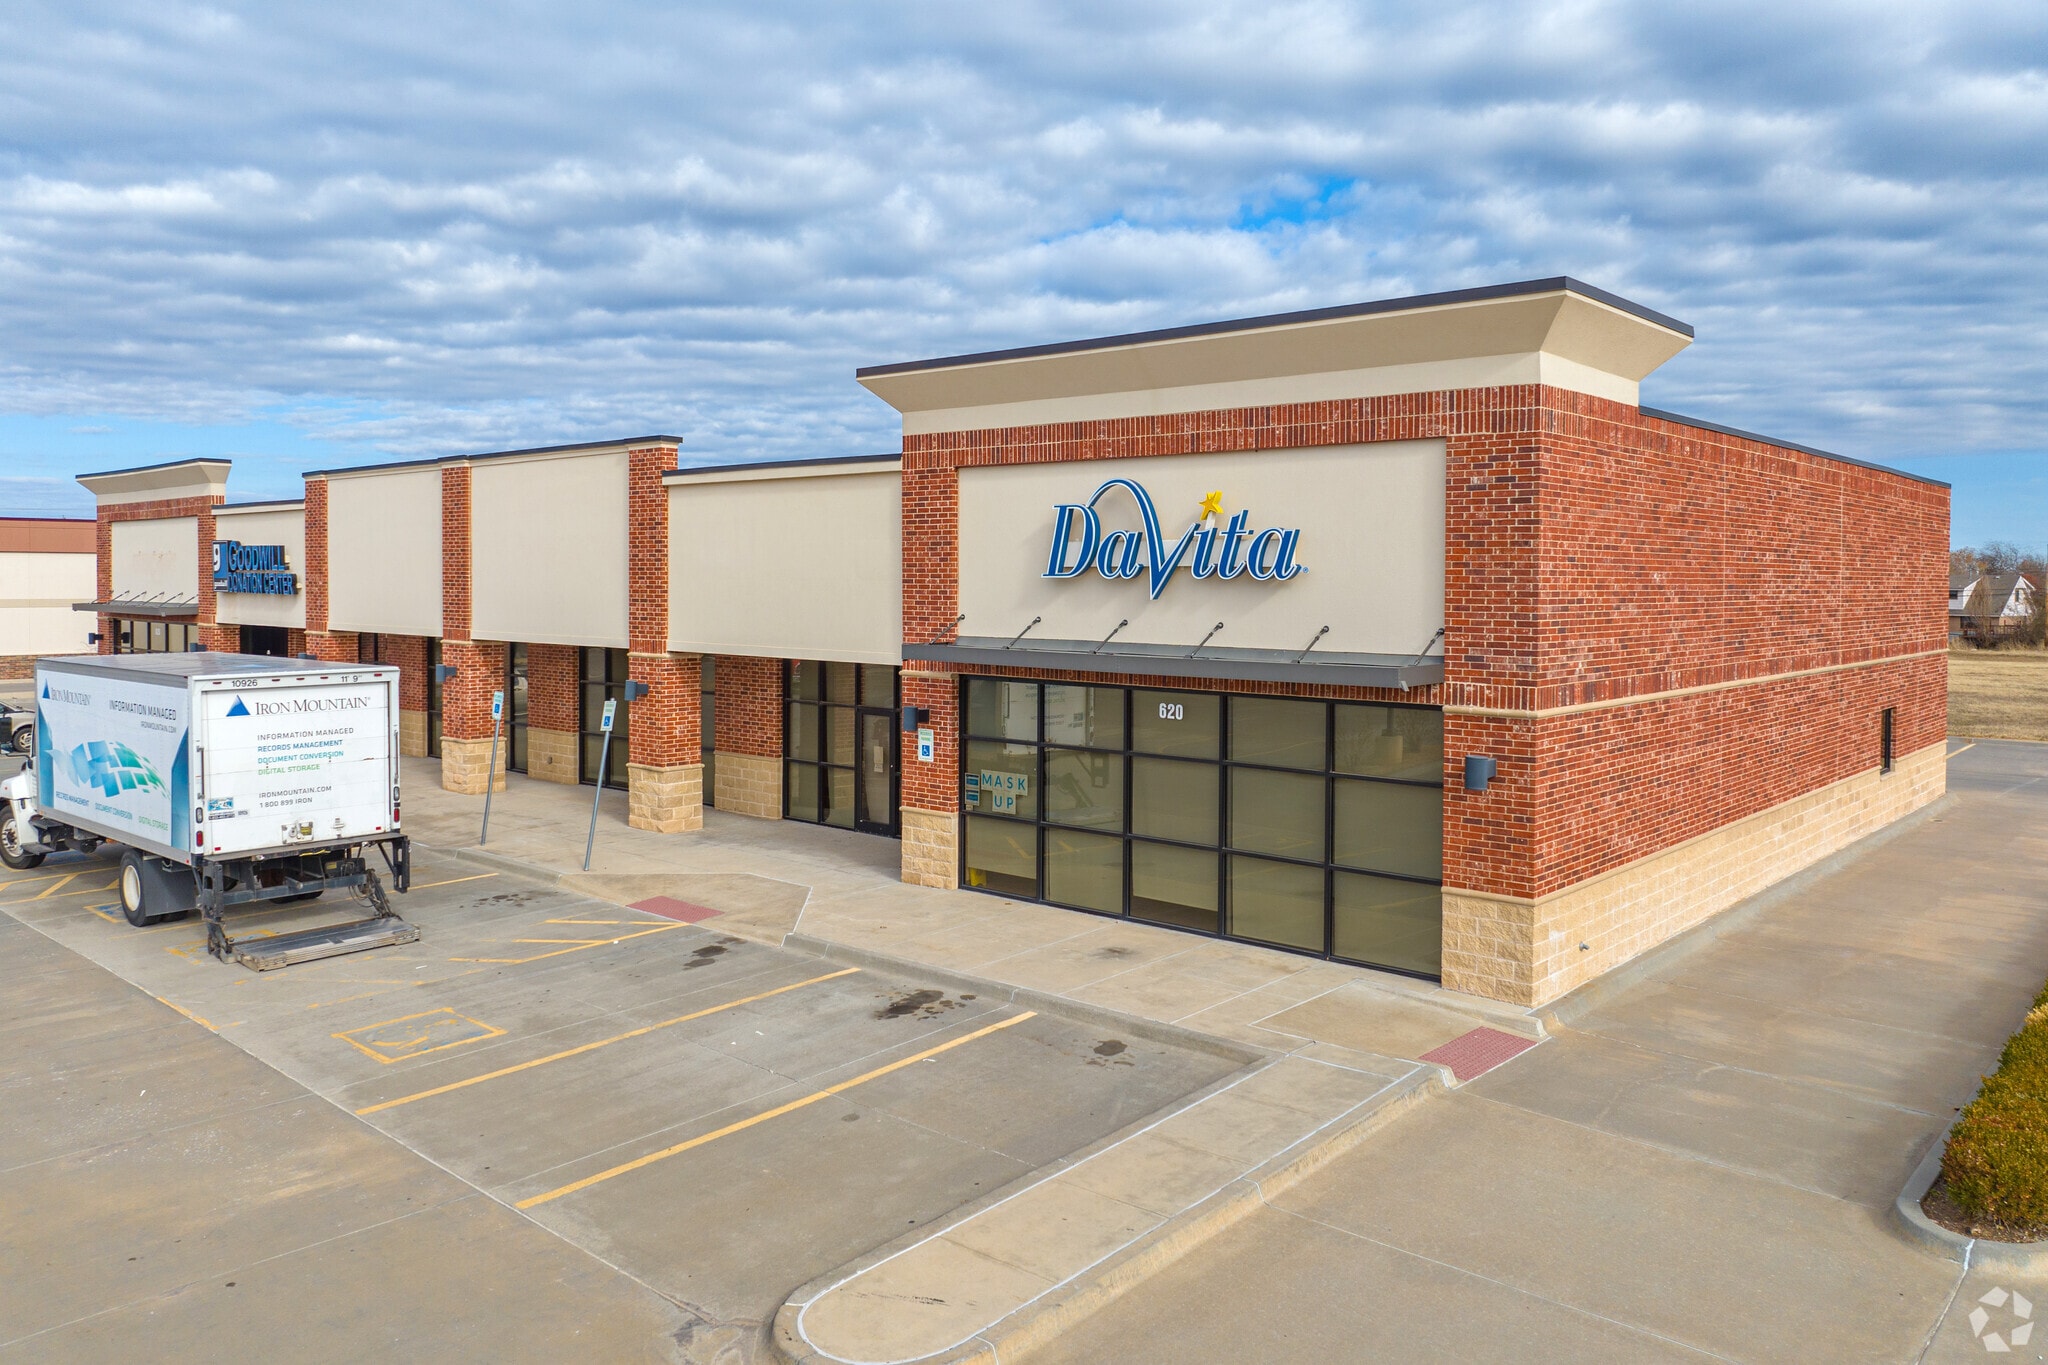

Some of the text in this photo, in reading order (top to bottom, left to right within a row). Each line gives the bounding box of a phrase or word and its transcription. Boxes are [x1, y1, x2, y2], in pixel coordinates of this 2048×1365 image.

[1041, 477, 1303, 601] DaVita
[228, 540, 287, 571] GOODWILL
[228, 572, 262, 594] DONATION
[263, 573, 295, 595] CENTER
[231, 678, 258, 688] 10926
[109, 699, 177, 721] INFORMATION MANAGED
[255, 697, 368, 716] IRON MOUNTAIN
[1159, 702, 1184, 720] 620
[257, 727, 354, 741] INFORMATION MANAGED
[257, 739, 343, 752] RECORDS MANAGEMENT
[257, 750, 344, 764] DOCUMENT CONVERSION
[257, 763, 321, 776] DIGITAL STORAGE
[982, 773, 1026, 791] MASK
[258, 785, 332, 799] IRONMOUNTAIN.COM
[994, 795, 1014, 809] UP
